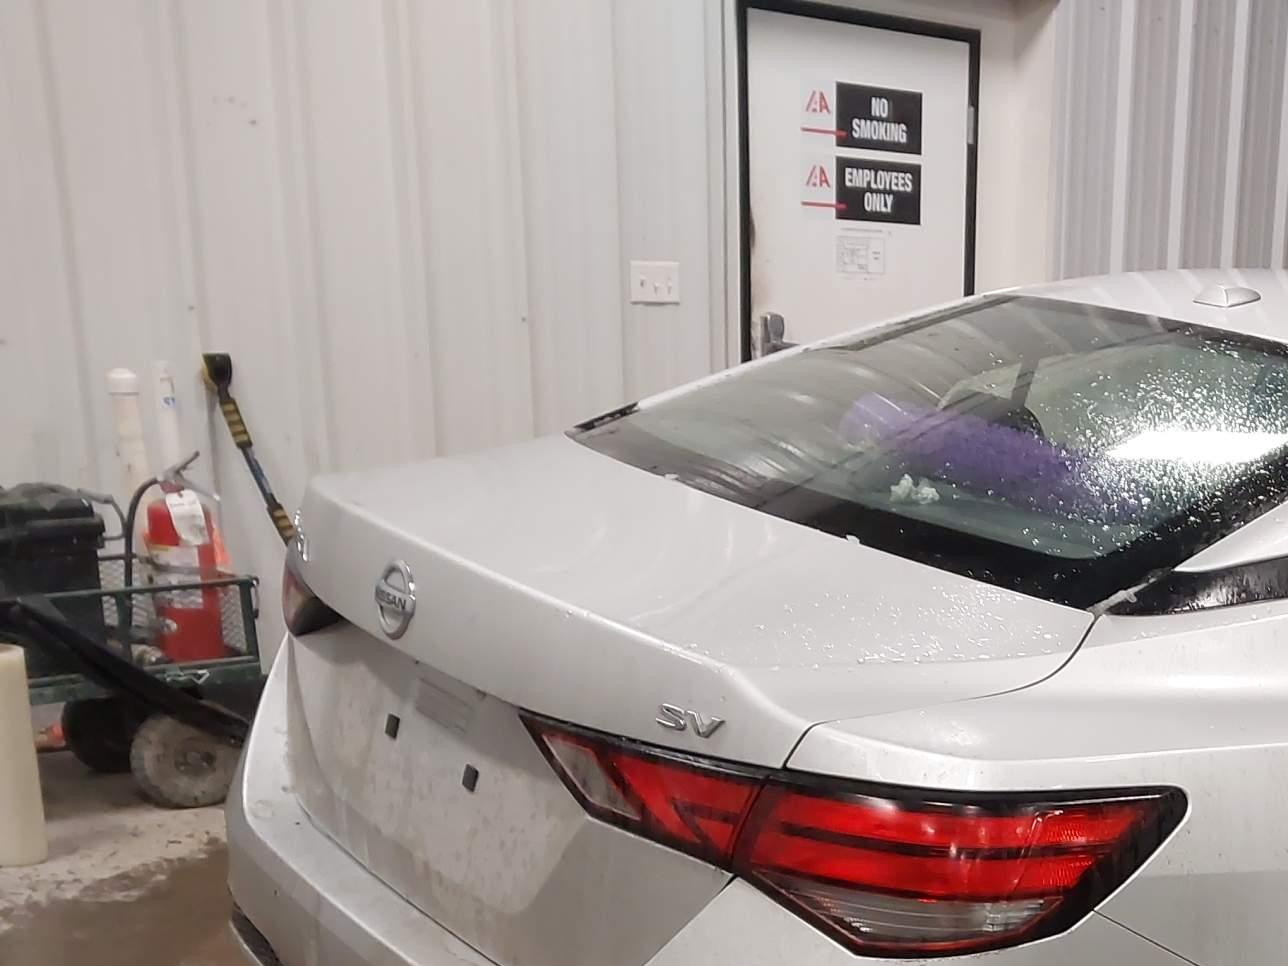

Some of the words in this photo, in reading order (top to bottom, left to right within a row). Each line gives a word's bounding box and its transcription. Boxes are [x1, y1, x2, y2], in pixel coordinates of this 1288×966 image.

[871, 97, 889, 118] NO
[852, 118, 907, 143] SMOKING
[845, 167, 913, 192] EMPLOYEES
[864, 192, 894, 213] ONLY
[656, 703, 725, 738] SV
